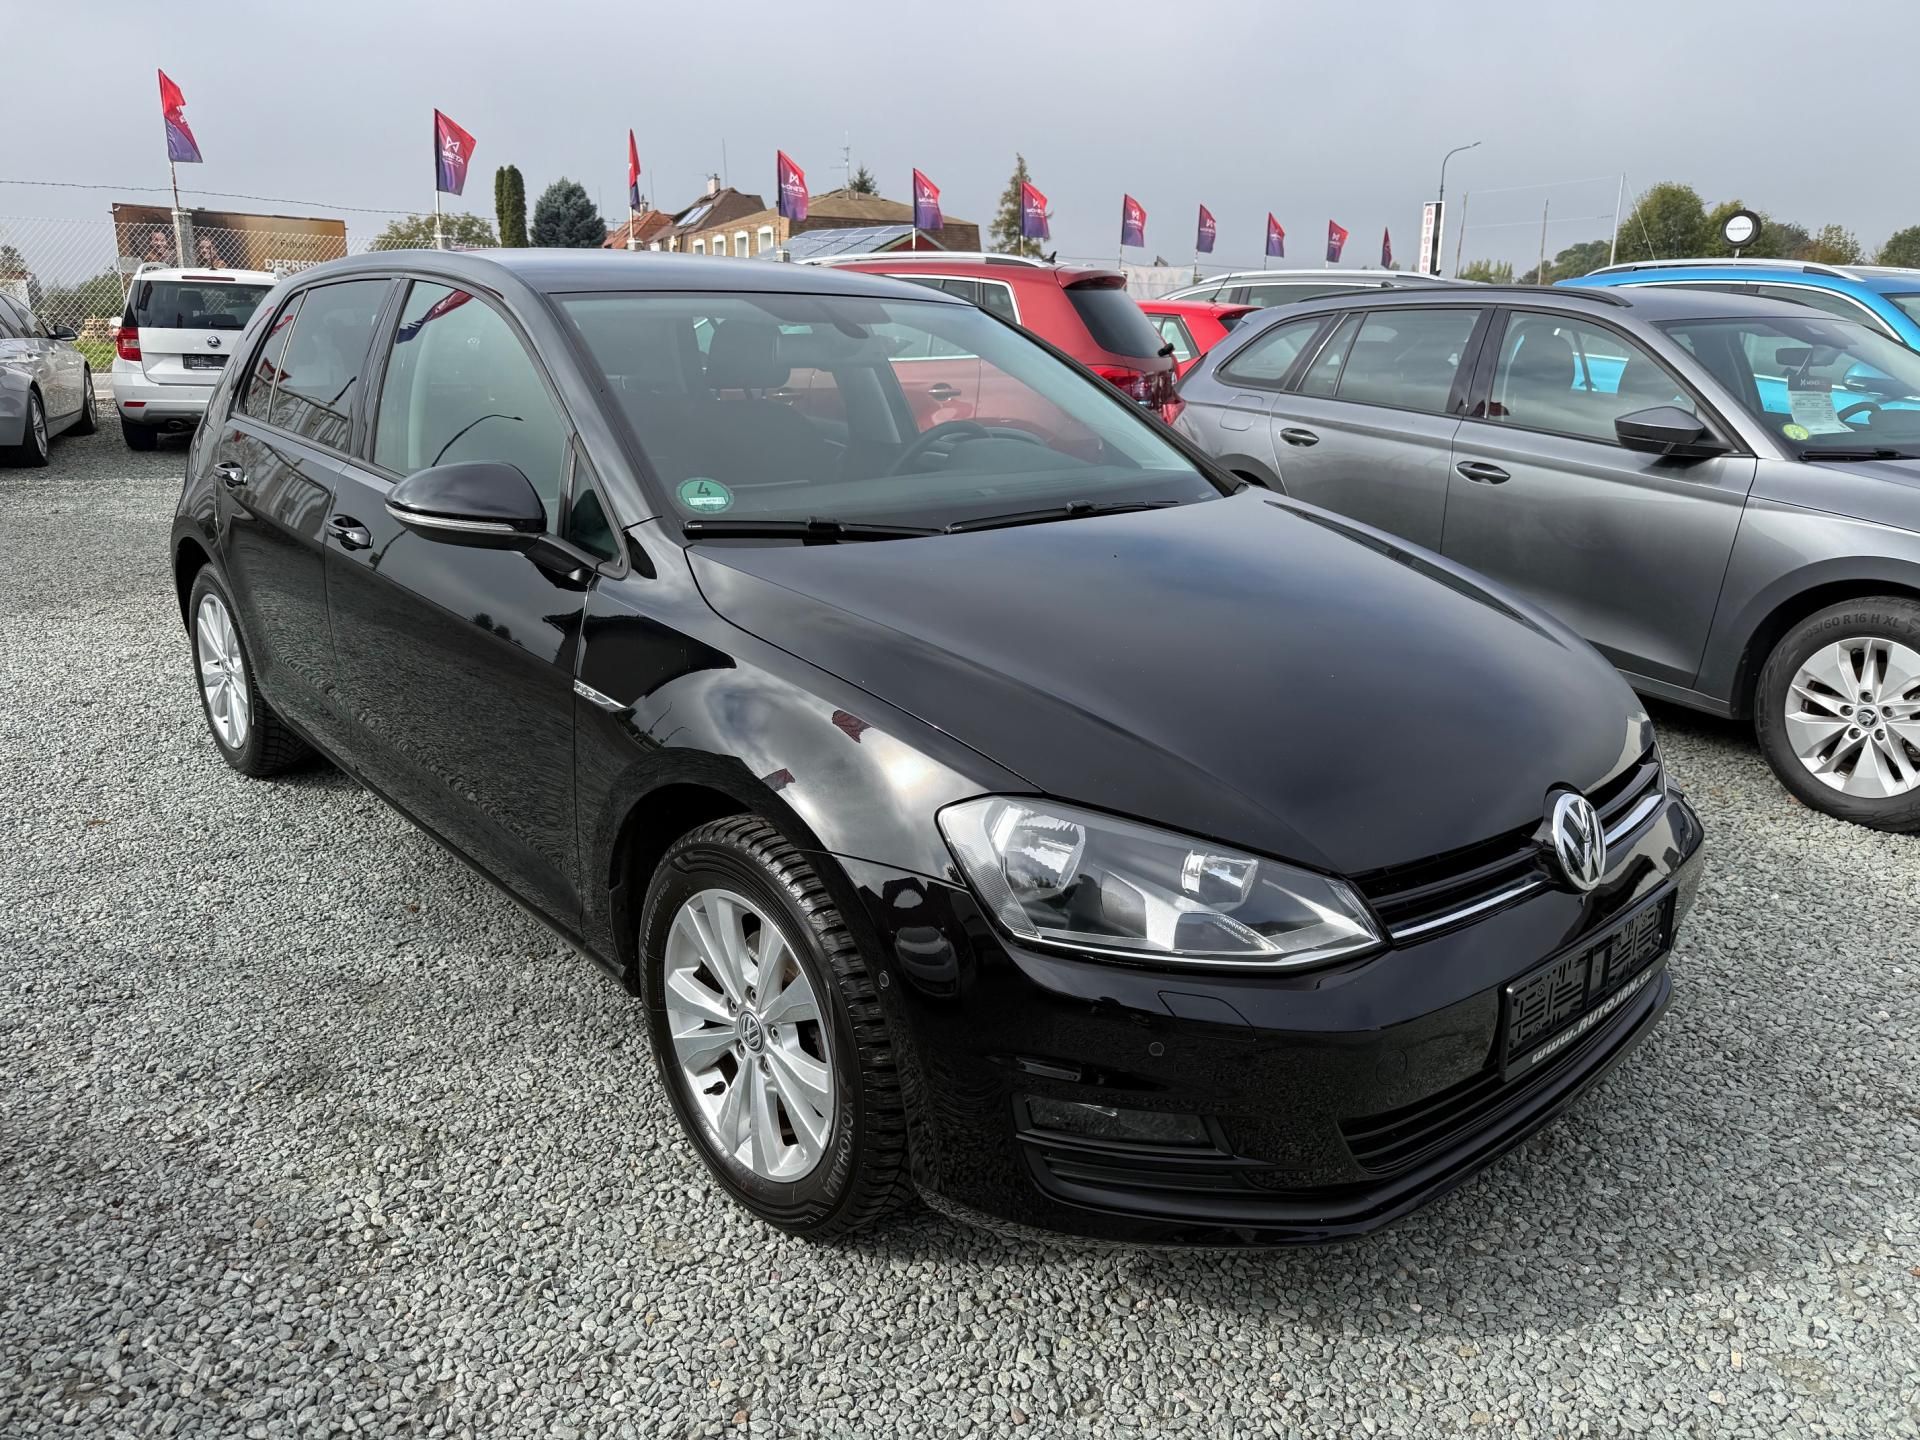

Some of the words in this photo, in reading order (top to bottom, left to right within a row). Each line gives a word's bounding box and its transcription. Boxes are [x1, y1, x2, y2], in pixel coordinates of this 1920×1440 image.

[697, 481, 711, 496] 4
[1871, 613, 1880, 624] H
[1883, 615, 1900, 628] XL
[823, 1102, 854, 1198] YOKOHAMA
